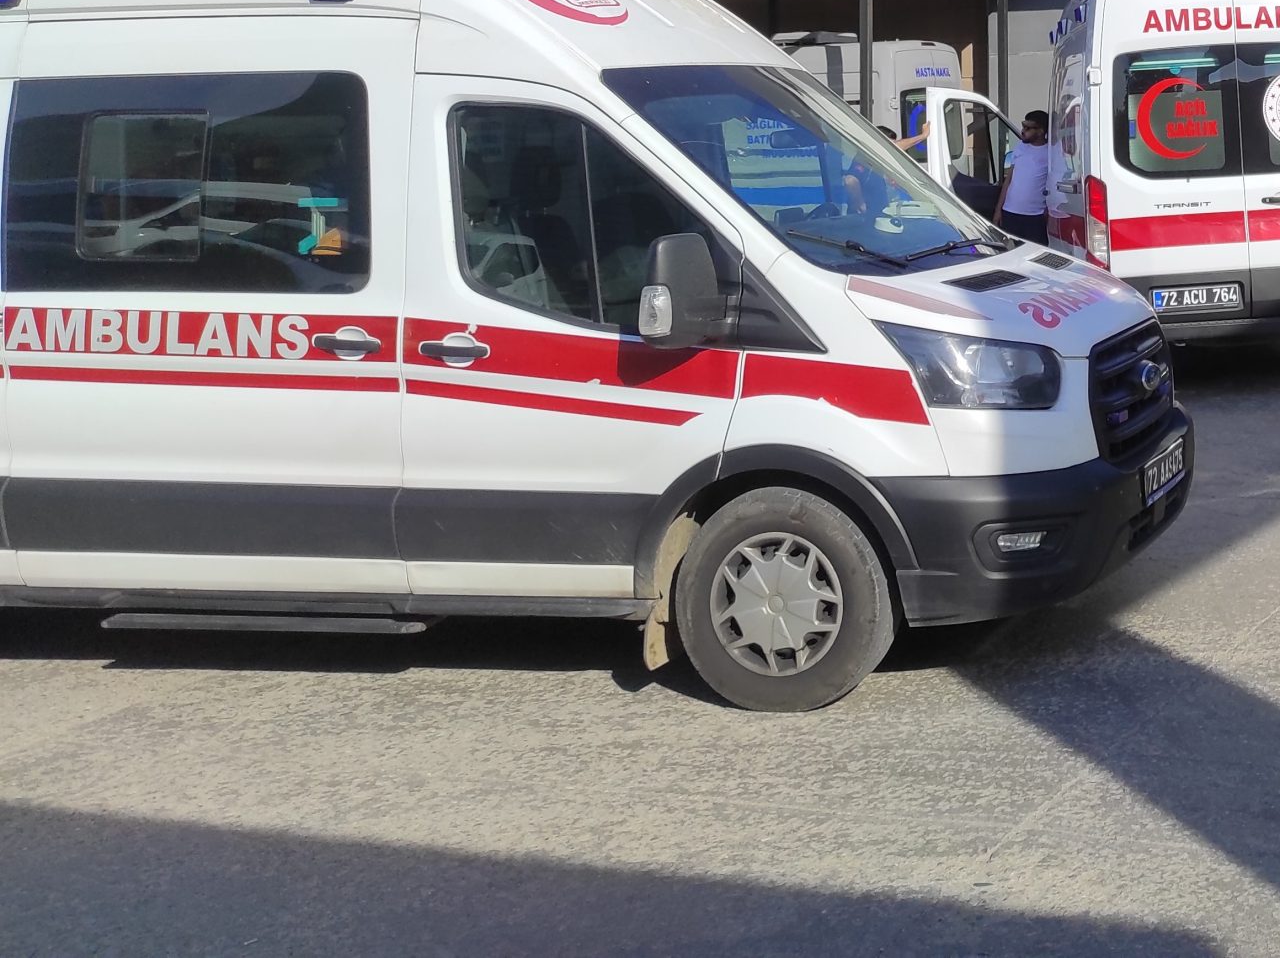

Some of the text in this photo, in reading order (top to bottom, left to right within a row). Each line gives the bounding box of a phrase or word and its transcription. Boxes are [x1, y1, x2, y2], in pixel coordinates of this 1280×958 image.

[915, 67, 935, 77] HASTA
[1153, 201, 1212, 209] TRANSIT
[1161, 287, 1237, 306] 72 ACU 764
[5, 308, 310, 360] AMBULANS
[1147, 466, 1158, 494] 72
